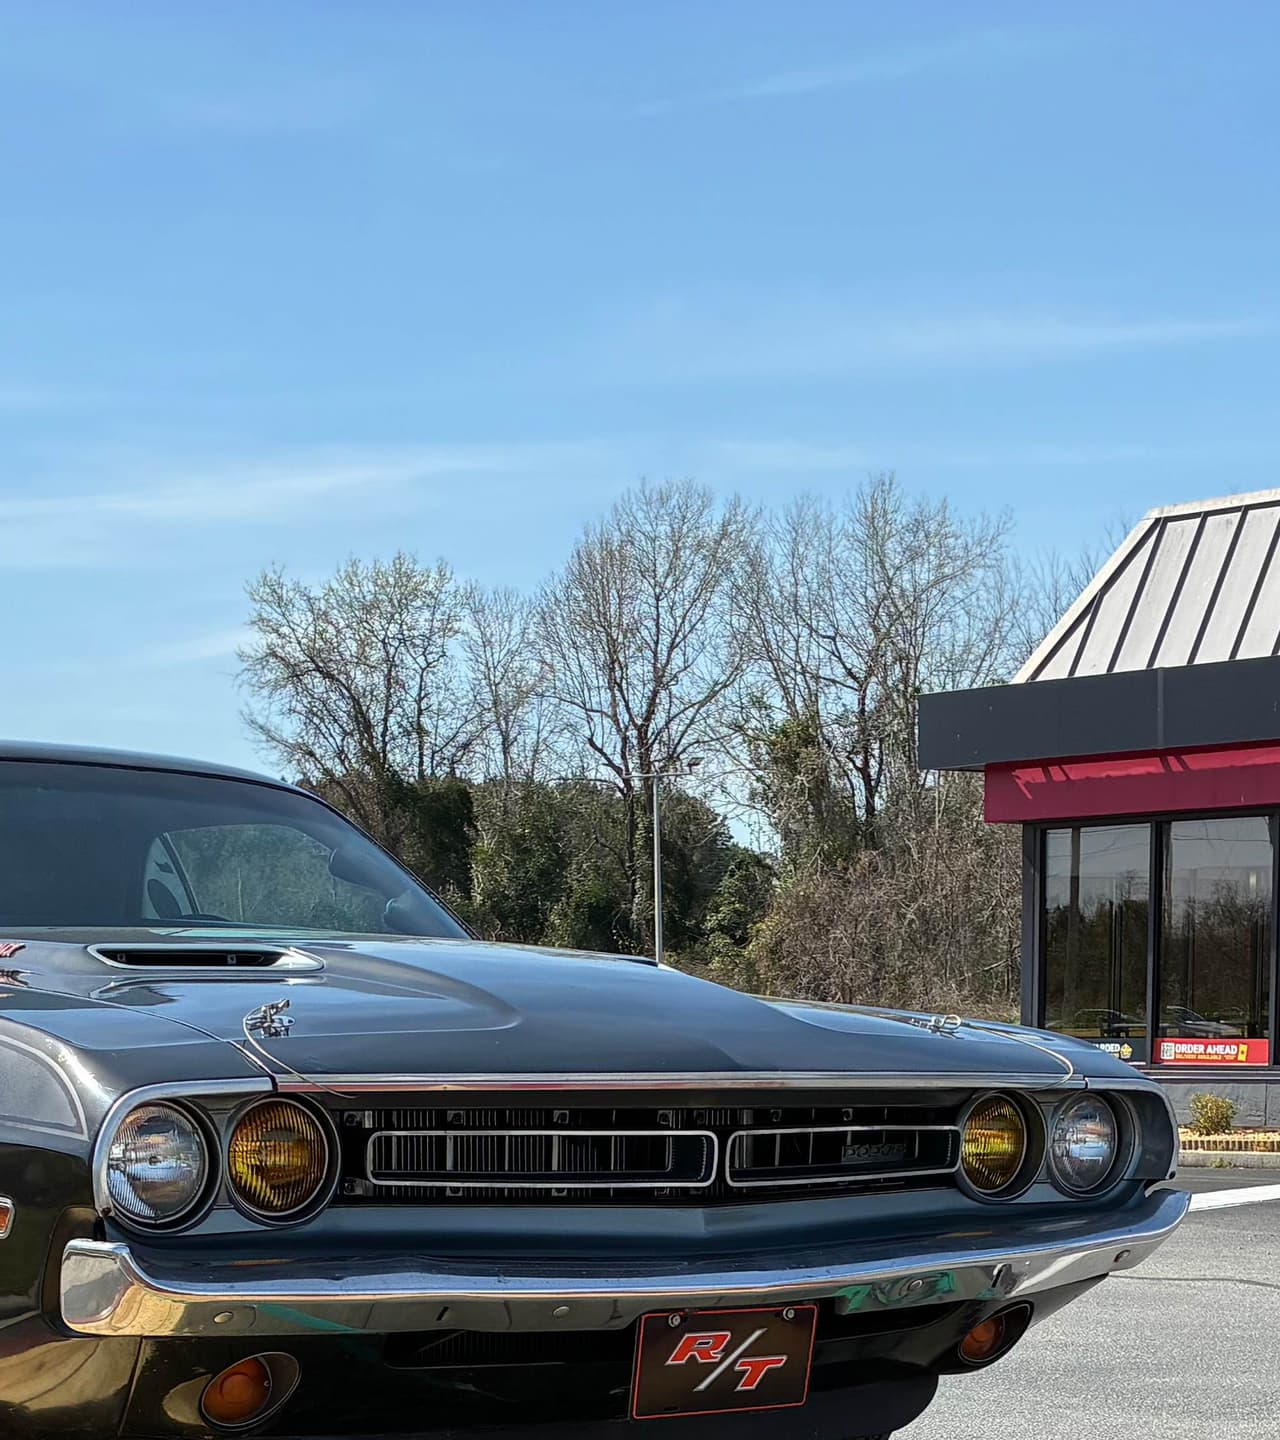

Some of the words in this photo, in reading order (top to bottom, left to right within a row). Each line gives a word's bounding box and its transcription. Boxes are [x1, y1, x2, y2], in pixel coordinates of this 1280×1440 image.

[1175, 1044, 1204, 1054] ORDER
[1206, 1044, 1237, 1054] AHEAD
[664, 1328, 788, 1392] R/T
